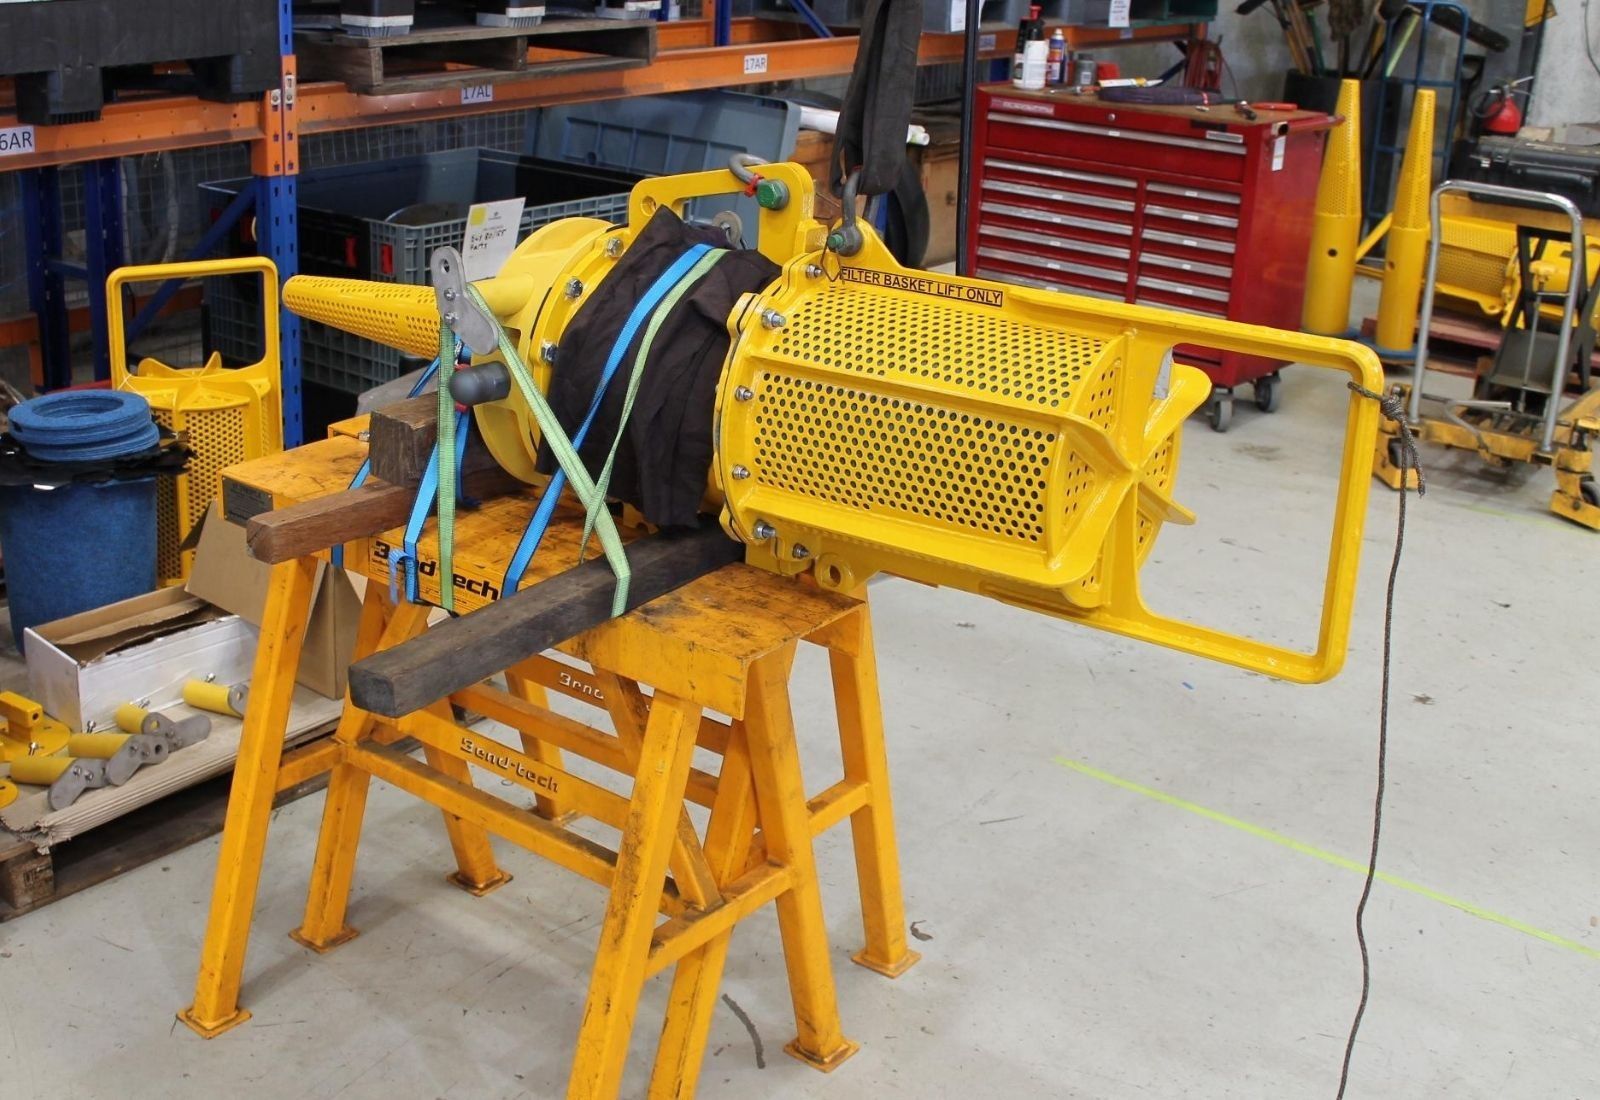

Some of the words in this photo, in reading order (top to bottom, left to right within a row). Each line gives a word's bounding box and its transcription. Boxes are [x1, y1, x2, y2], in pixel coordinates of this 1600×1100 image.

[746, 57, 766, 71] 17AR
[841, 268, 880, 285] FILTER
[884, 275, 933, 292] BASKET
[937, 283, 963, 298] LIFT
[967, 288, 1000, 304] ONLY
